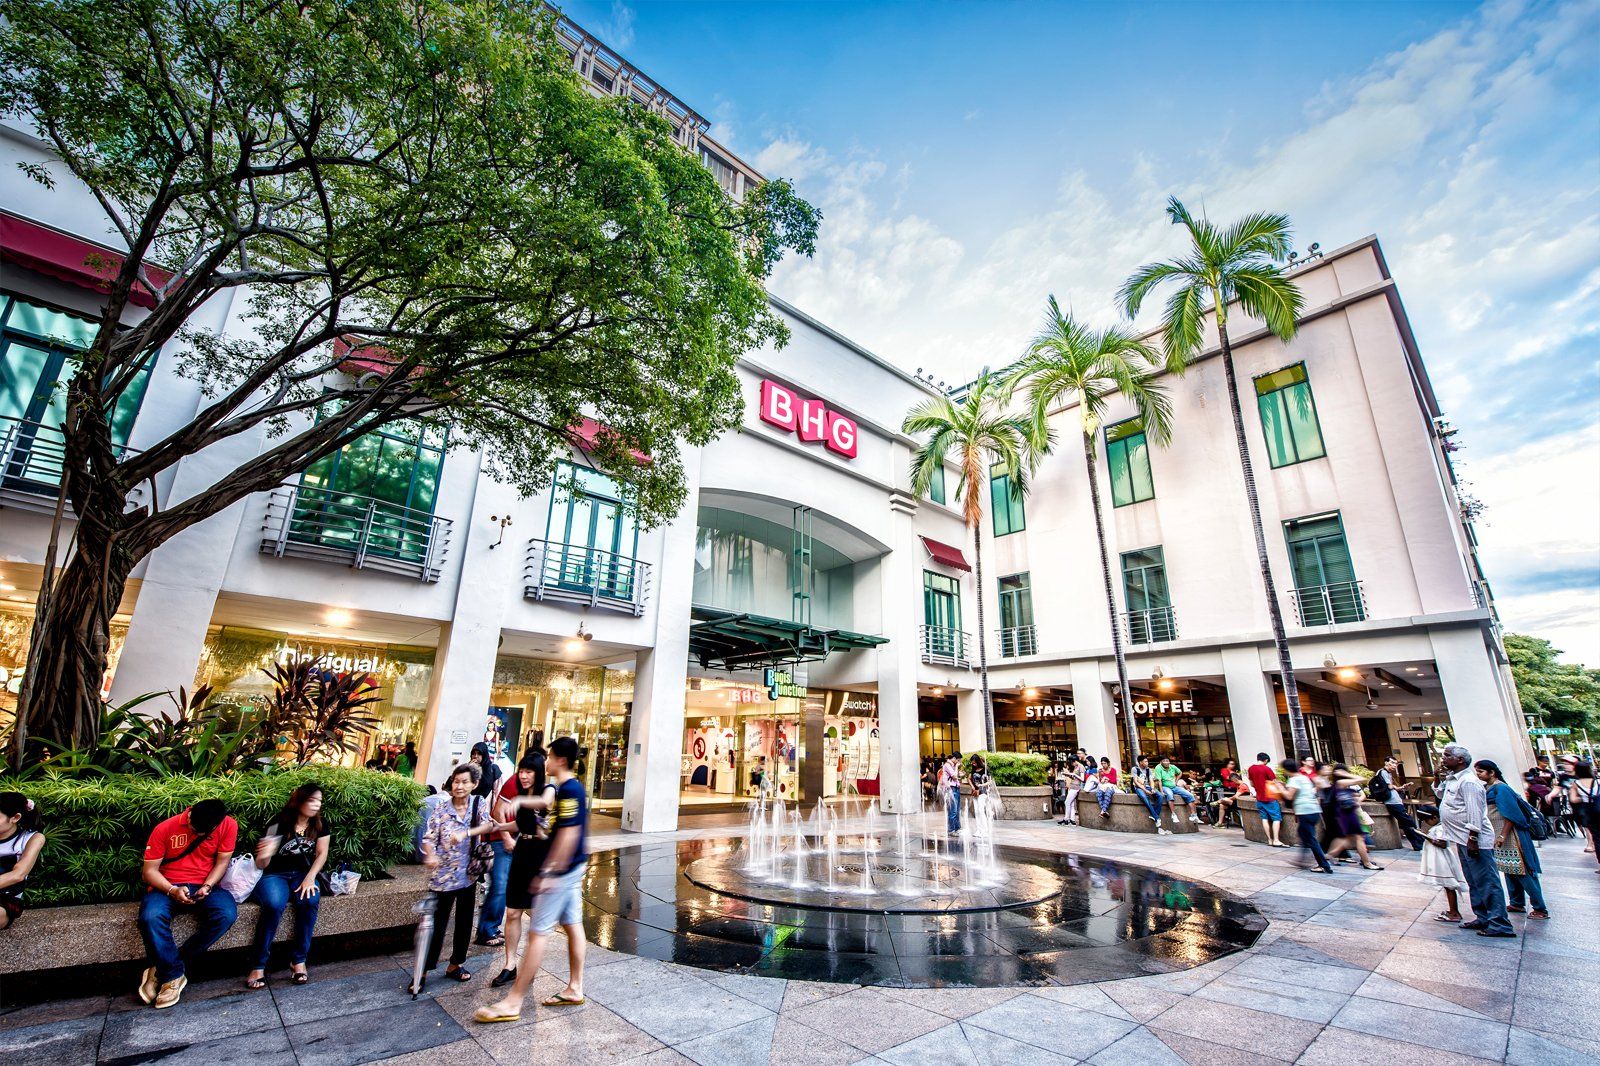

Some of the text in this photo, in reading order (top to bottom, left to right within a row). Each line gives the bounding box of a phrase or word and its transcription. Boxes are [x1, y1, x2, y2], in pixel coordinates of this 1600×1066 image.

[770, 385, 854, 450] BHG
[767, 669, 791, 686] Bugis
[731, 689, 761, 703] BHG
[771, 683, 807, 699] Junction
[844, 700, 872, 710] swatch
[1025, 699, 1193, 717] STARBS OFFEE
[170, 834, 188, 849] 10
